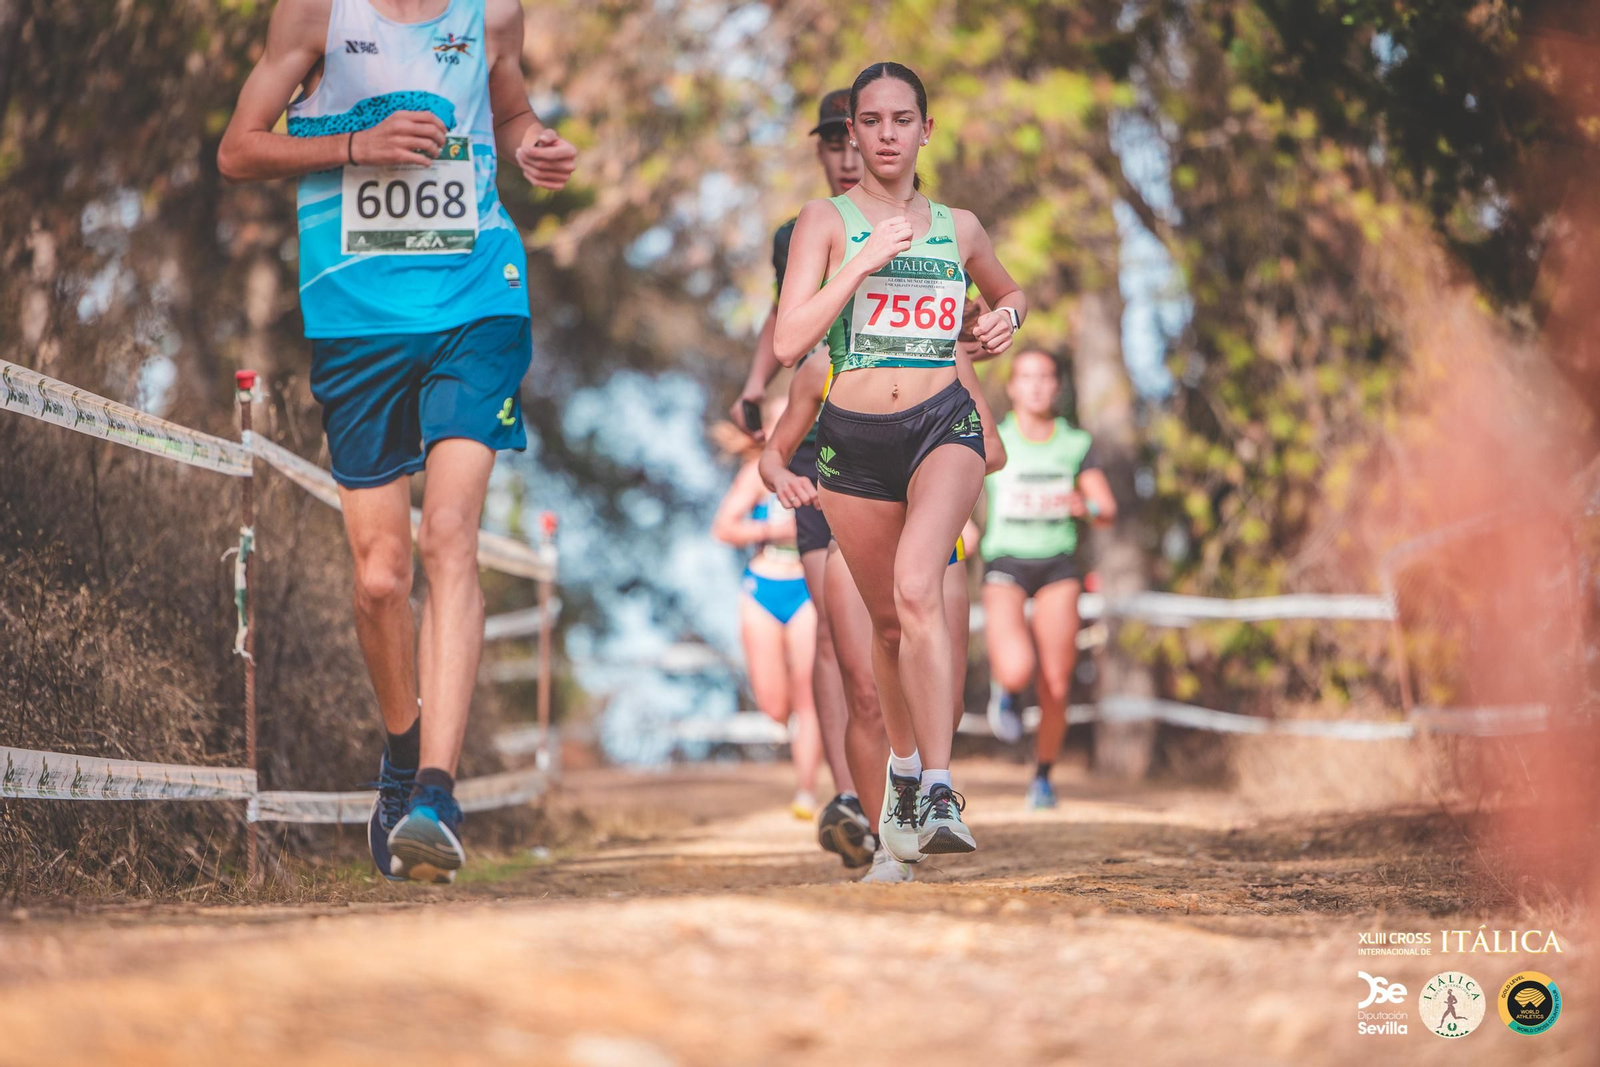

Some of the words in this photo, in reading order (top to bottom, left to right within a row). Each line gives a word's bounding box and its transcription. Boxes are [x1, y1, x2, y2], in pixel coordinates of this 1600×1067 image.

[357, 180, 466, 219] 6068
[890, 257, 940, 272] ITÁLICA
[866, 293, 956, 331] 7568
